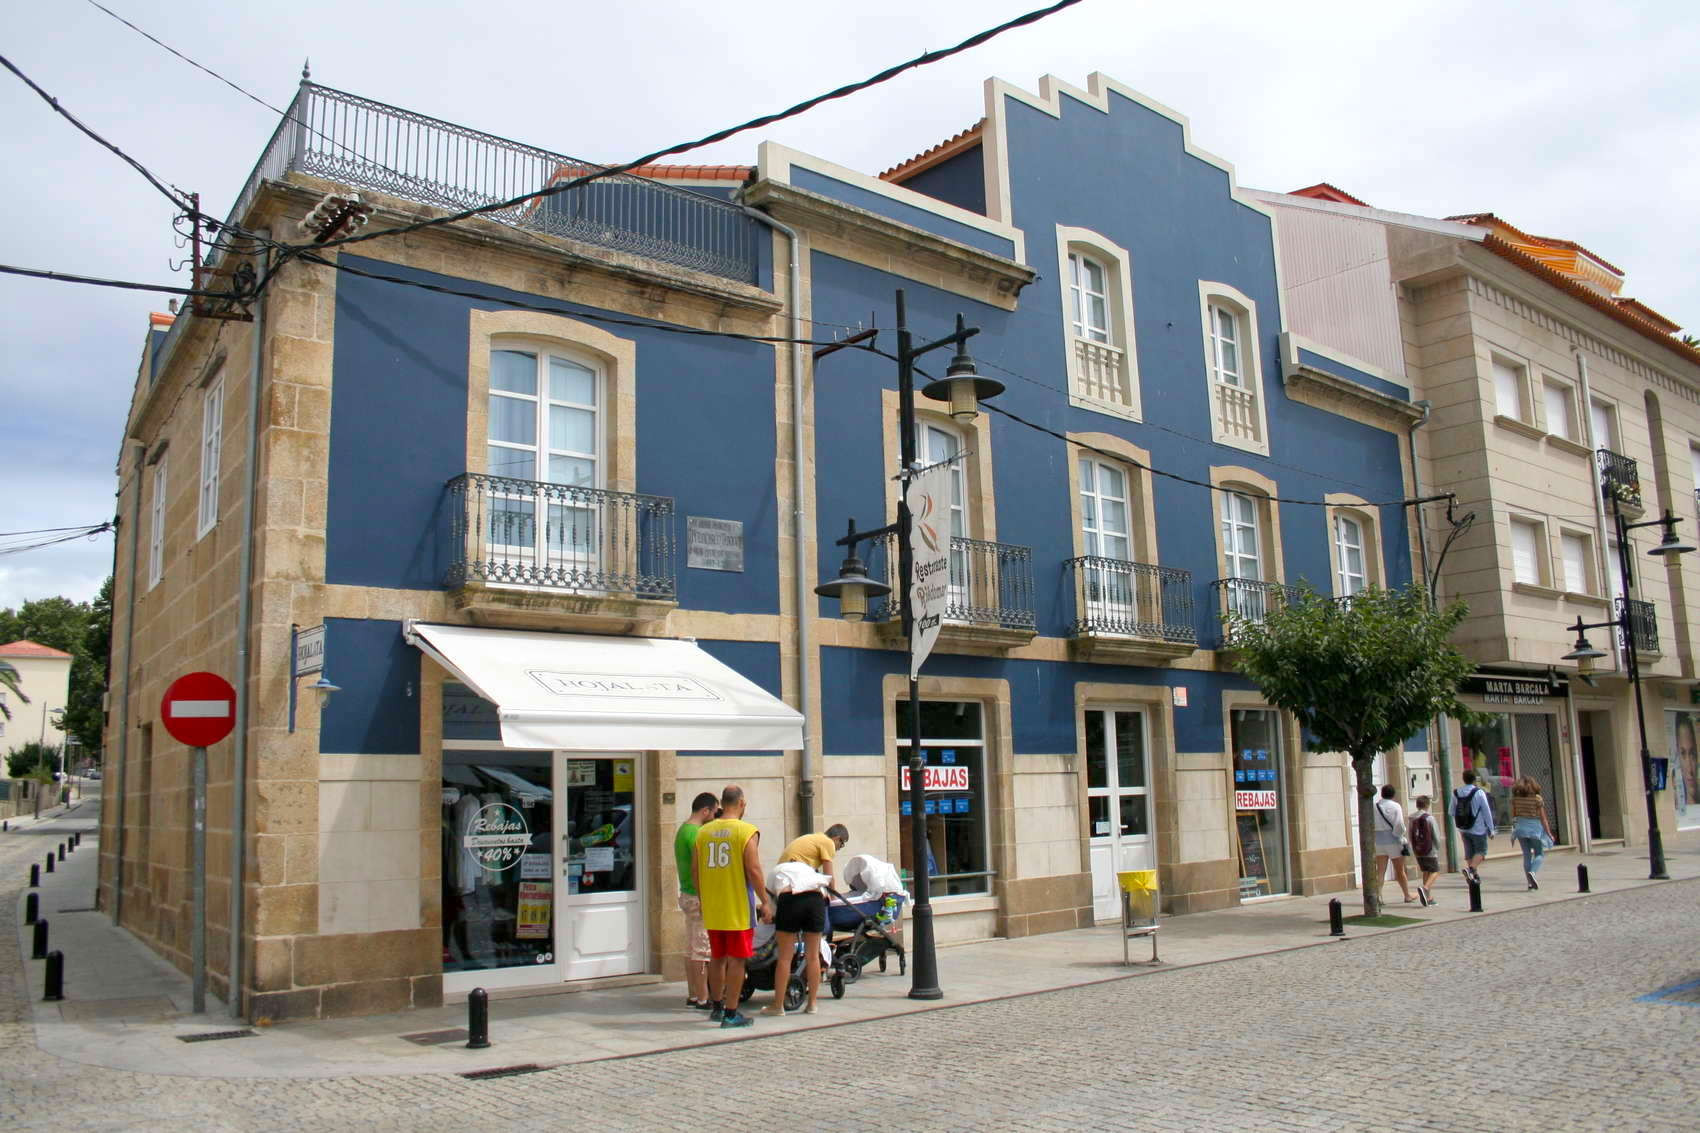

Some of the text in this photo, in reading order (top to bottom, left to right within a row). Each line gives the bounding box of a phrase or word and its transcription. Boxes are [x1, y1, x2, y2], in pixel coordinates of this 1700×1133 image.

[1486, 681, 1550, 696] MARTA BARCALA
[903, 768, 967, 788] RBAJAS
[1236, 792, 1276, 808] REBAJAS
[473, 818, 521, 834] Rebajas
[484, 847, 513, 861] 40%
[707, 841, 730, 868] 16
